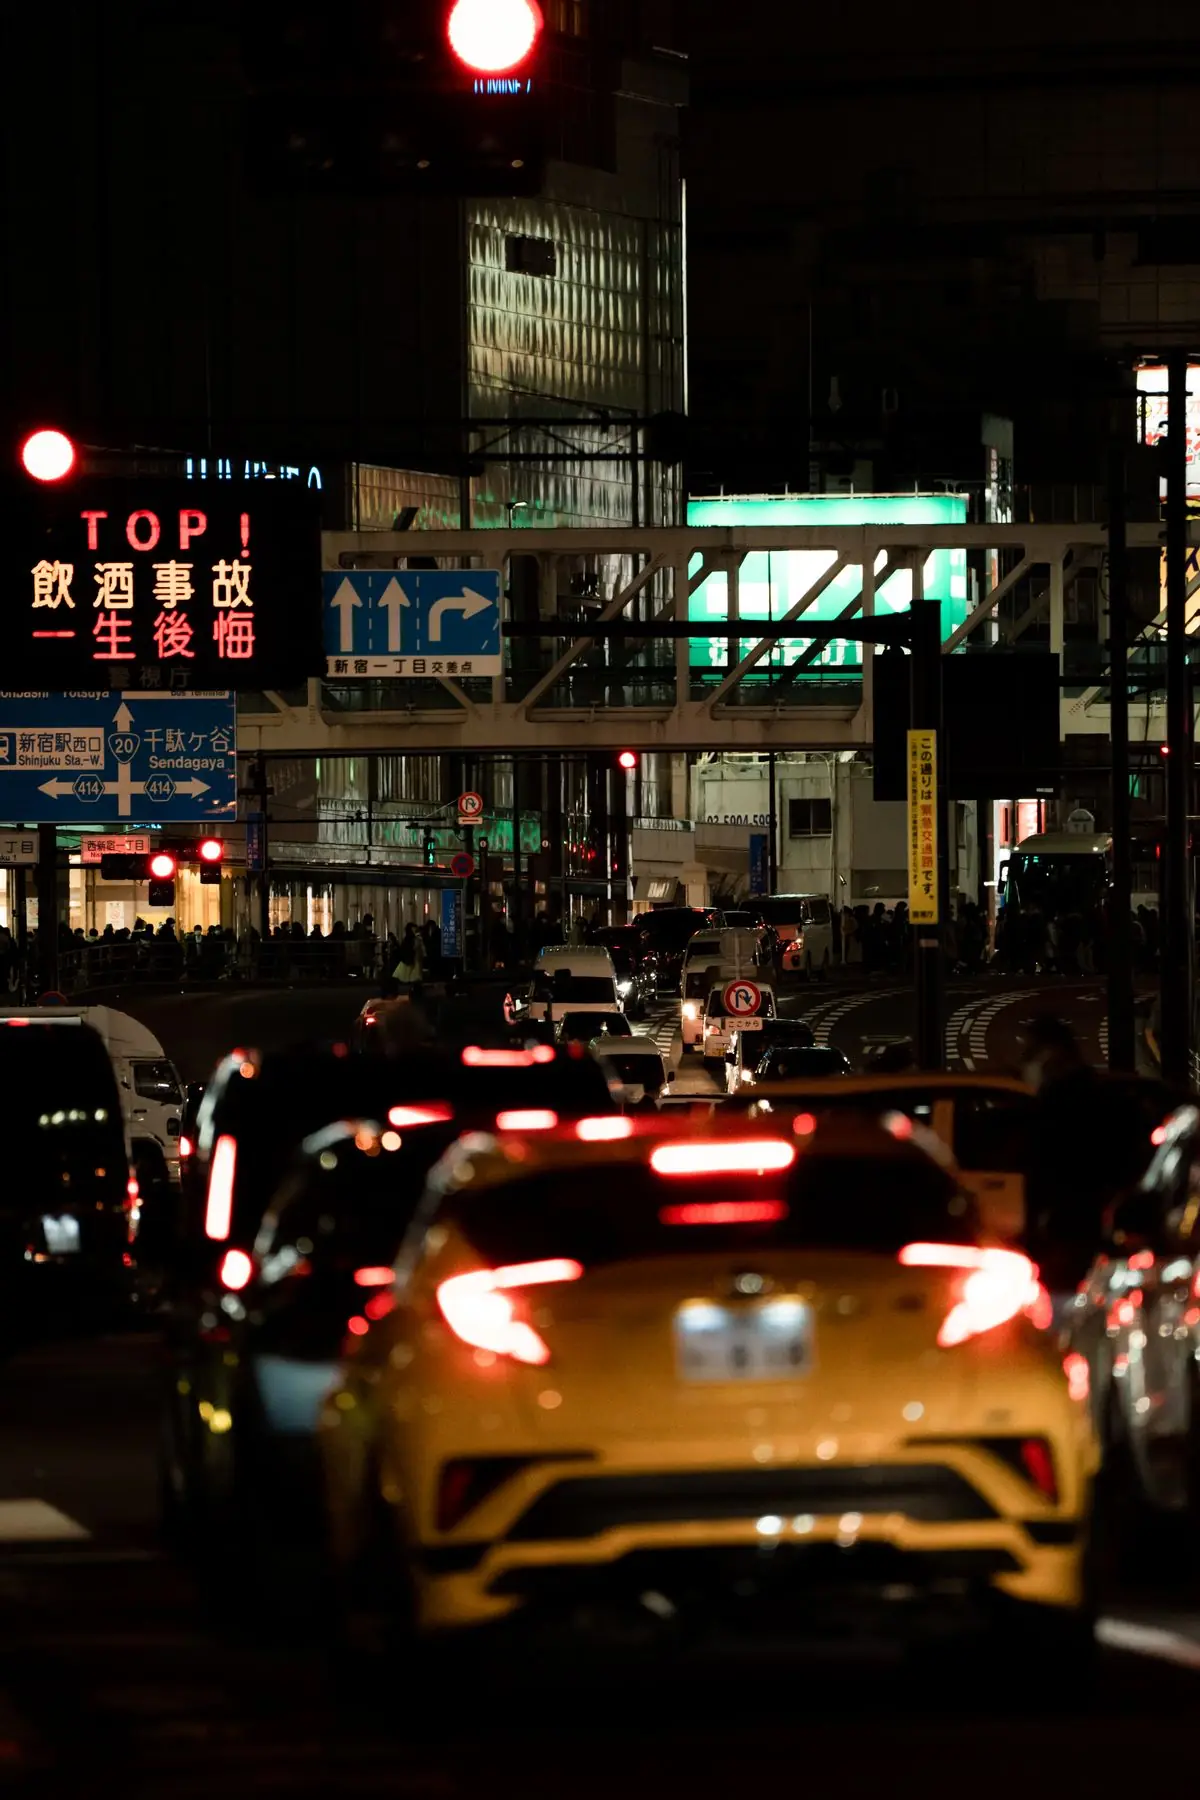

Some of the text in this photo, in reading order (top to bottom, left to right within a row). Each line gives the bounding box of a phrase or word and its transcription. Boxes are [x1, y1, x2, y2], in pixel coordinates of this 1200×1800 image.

[30, 559, 254, 609] 飲酒事故
[32, 610, 256, 660] 一生後悔
[326, 658, 473, 674] 新宿一丁目交差点
[19, 733, 102, 753] 新宿駅西口
[114, 738, 134, 754] 20
[18, 755, 61, 767] Shinjuku
[149, 756, 225, 770] Sendagaya
[78, 781, 99, 795] 414
[149, 781, 170, 795] 414
[87, 839, 144, 851] 西新宿一丁目
[728, 1020, 760, 1028] ここから
